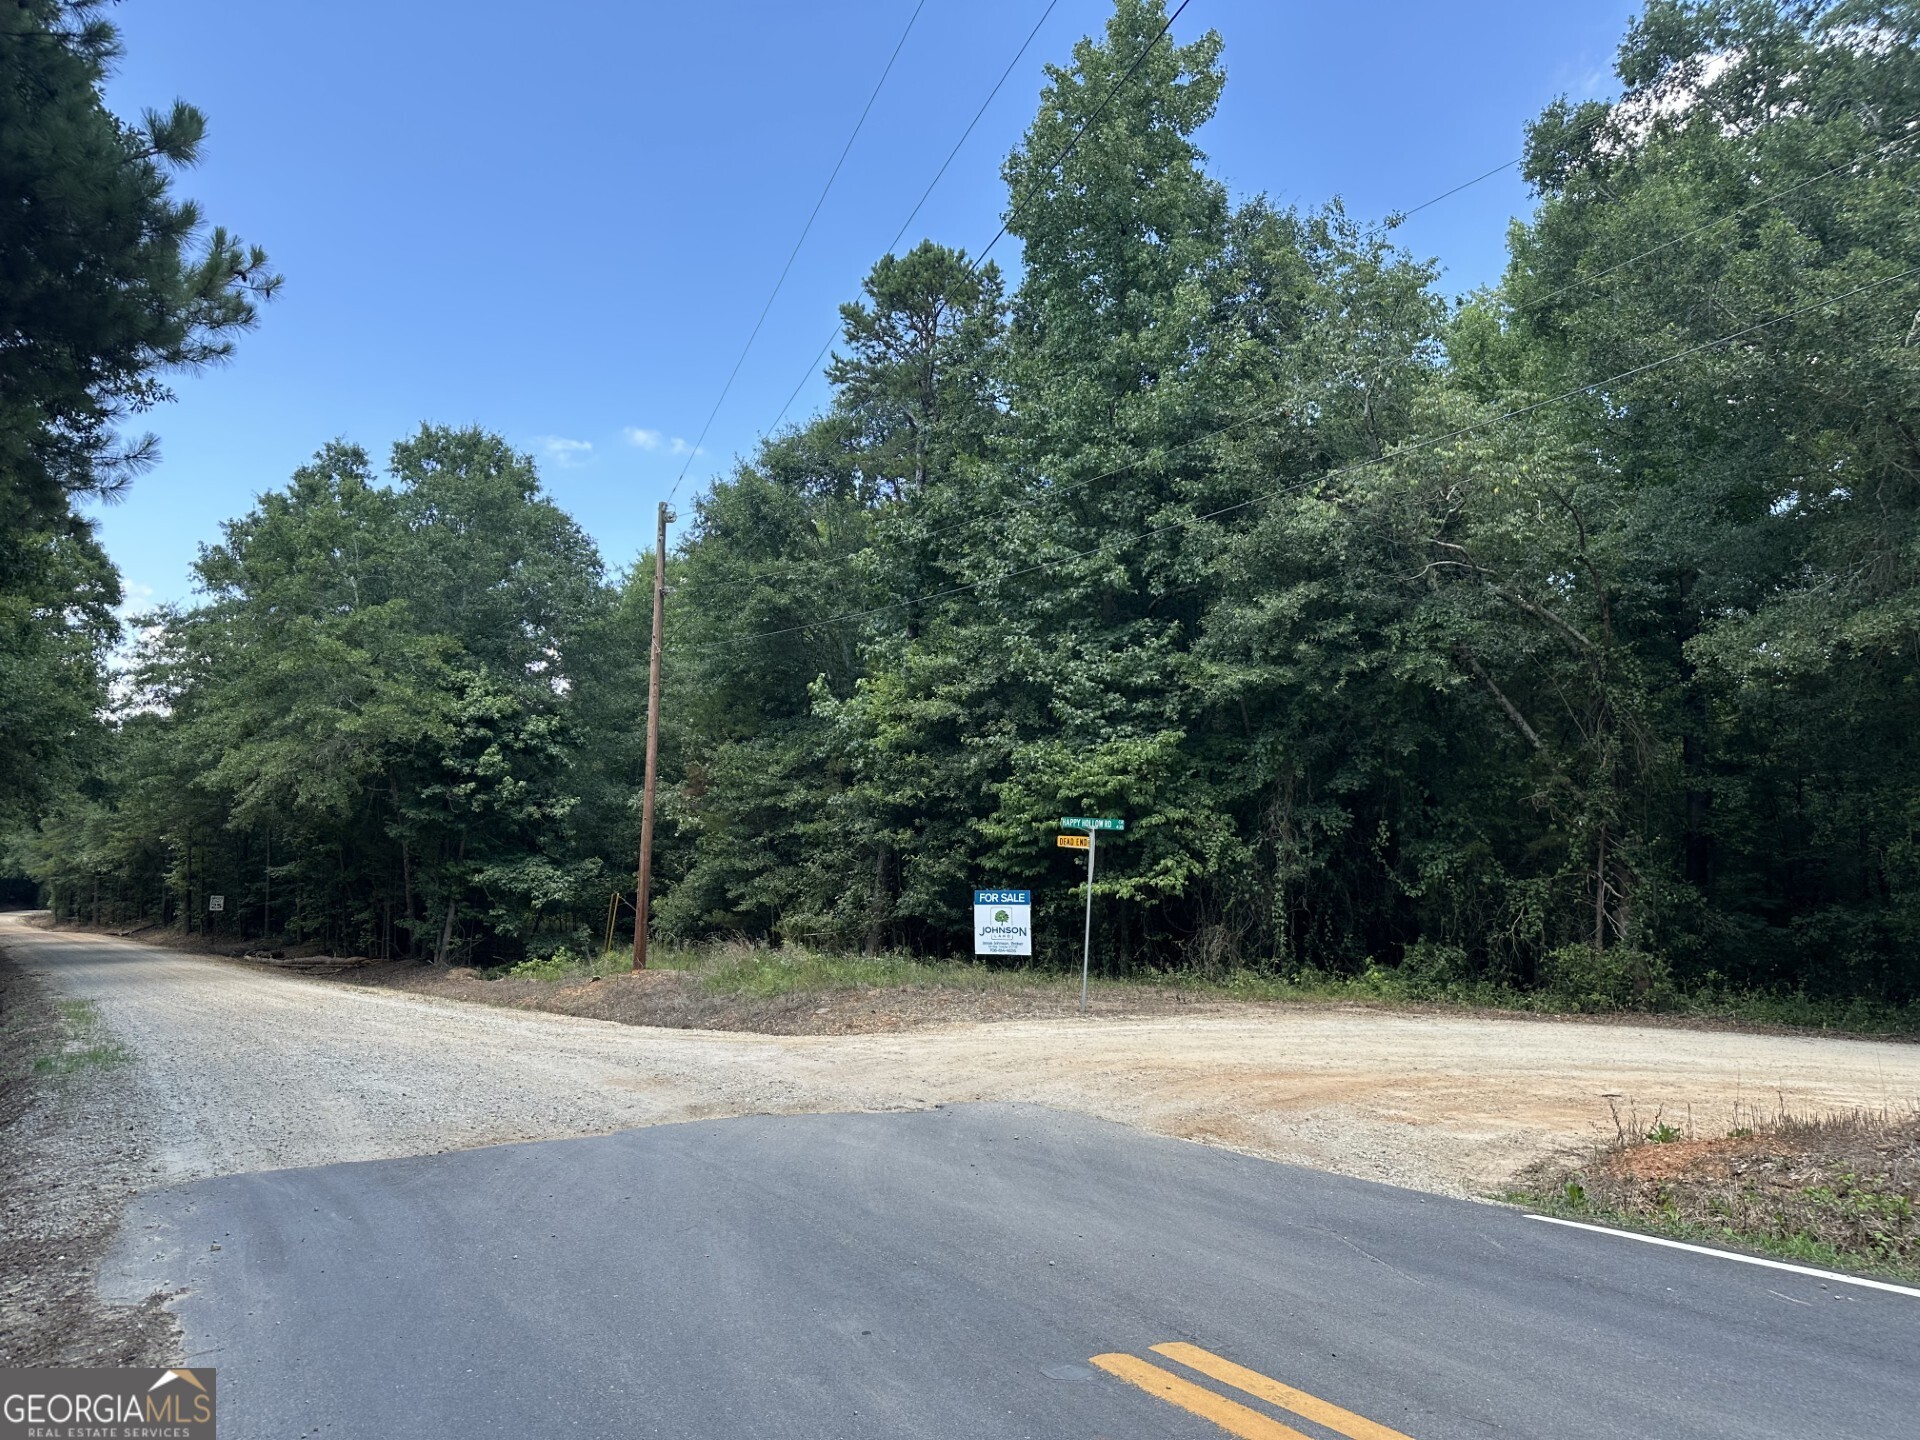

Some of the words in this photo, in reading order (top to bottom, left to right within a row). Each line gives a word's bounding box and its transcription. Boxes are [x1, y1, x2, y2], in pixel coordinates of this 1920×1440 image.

[1062, 818, 1081, 827] HAPPY
[1081, 819, 1104, 828] HOLLOW
[1104, 820, 1112, 828] RD
[1059, 837, 1075, 846] DEAD
[1076, 838, 1088, 846] END
[979, 893, 999, 902] FOR
[1001, 893, 1025, 902] SALE
[979, 926, 1027, 936] JOHNSON
